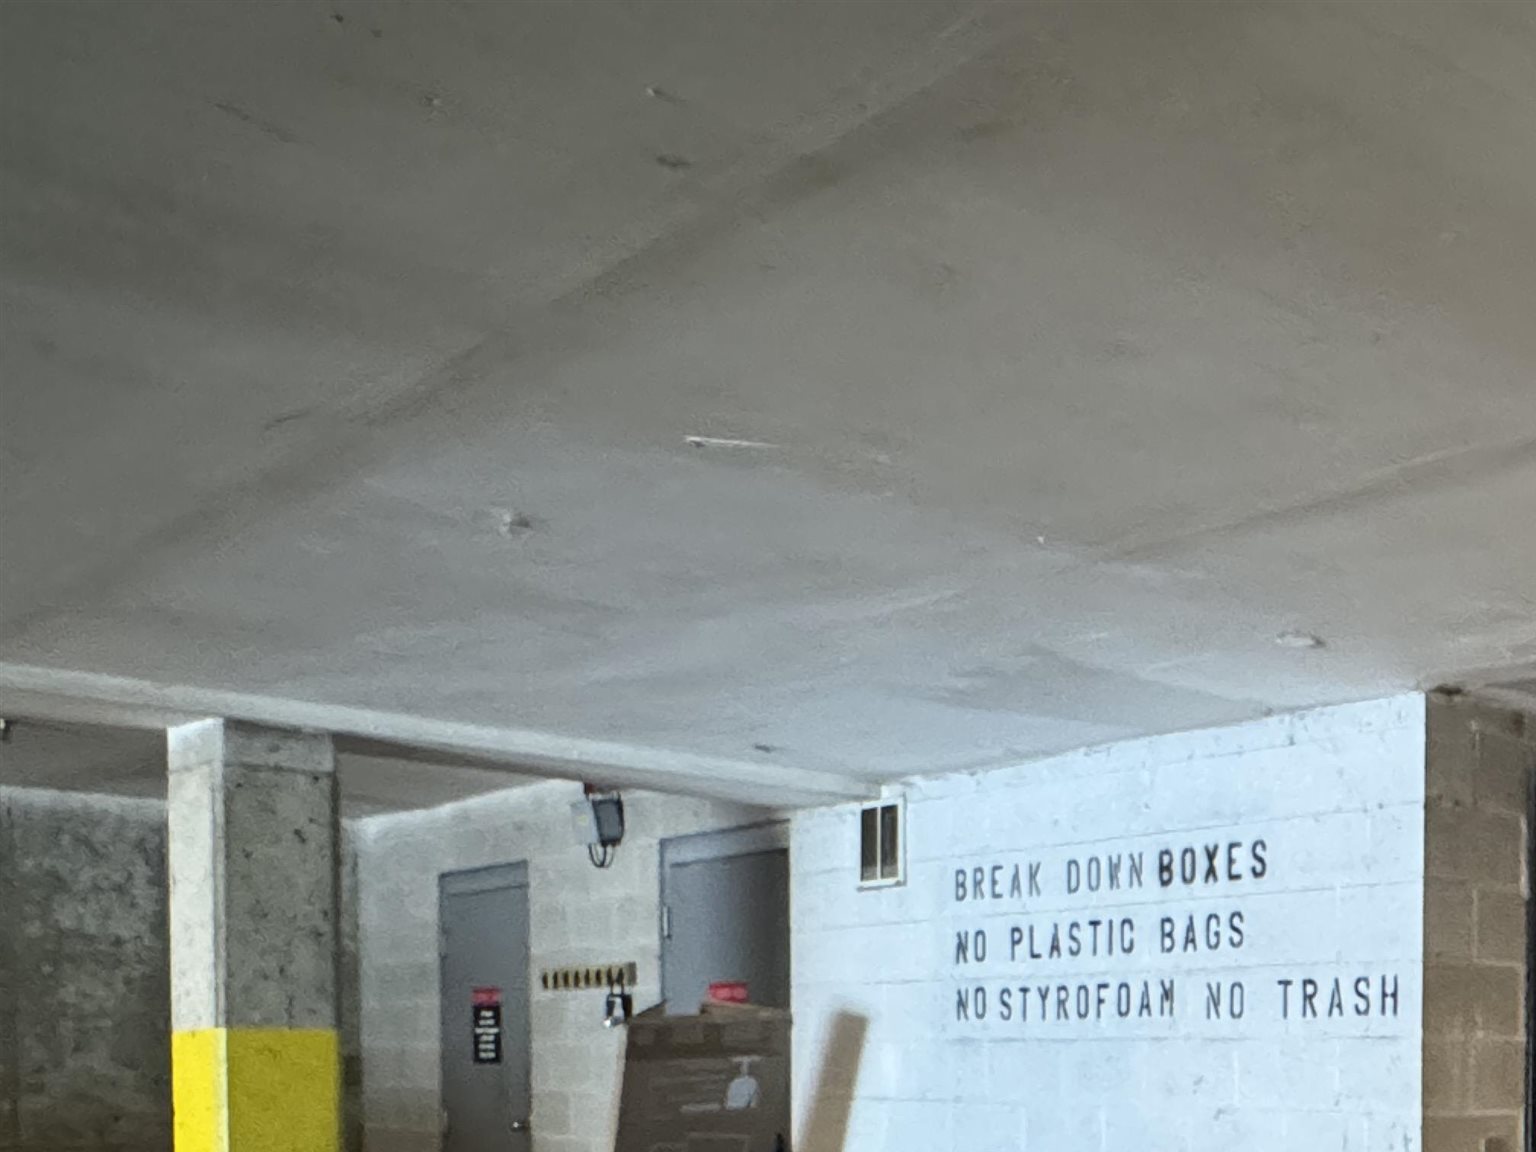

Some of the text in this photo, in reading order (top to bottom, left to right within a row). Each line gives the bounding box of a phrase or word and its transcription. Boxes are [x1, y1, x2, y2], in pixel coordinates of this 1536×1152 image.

[954, 838, 1268, 902] BREAK DOWN BOXES
[955, 910, 1245, 965] NO PLASTIC BAGS
[955, 973, 1399, 1022] NO STYROFOAM NO TRASH
